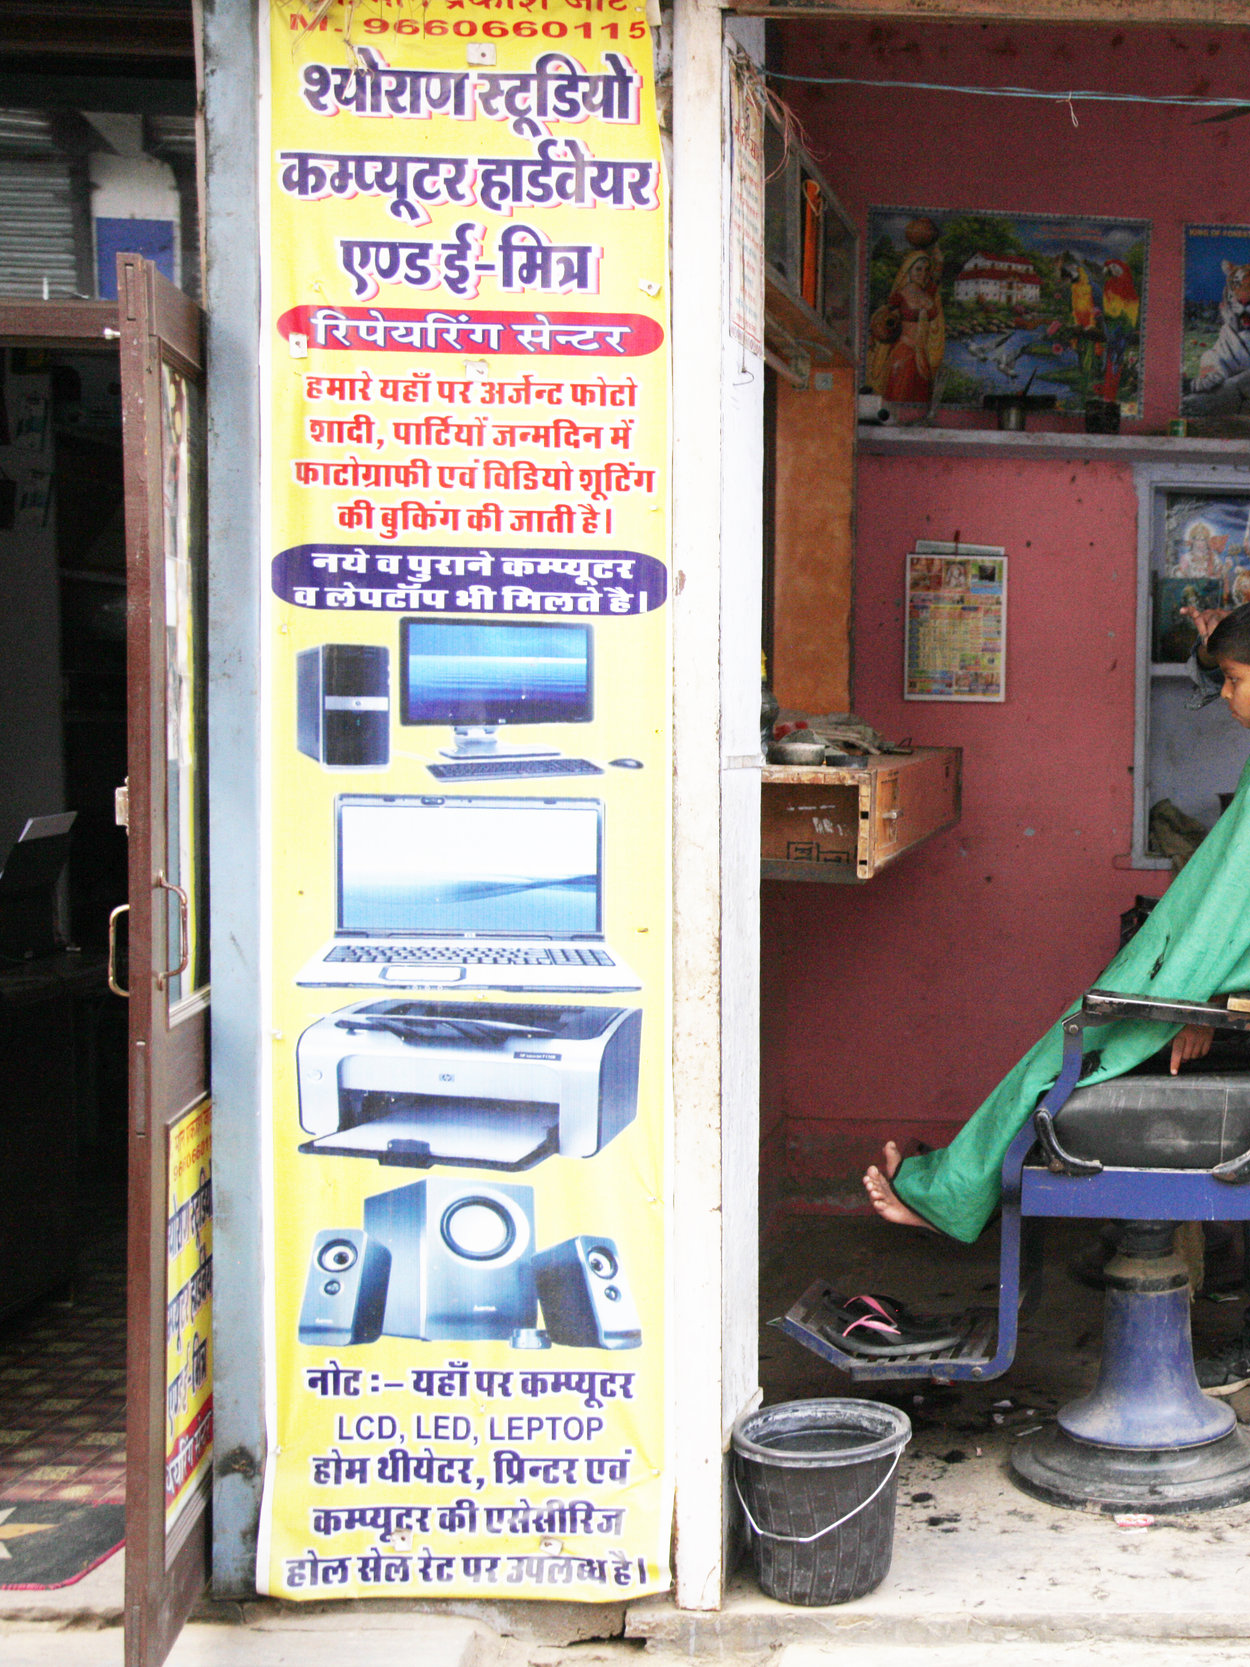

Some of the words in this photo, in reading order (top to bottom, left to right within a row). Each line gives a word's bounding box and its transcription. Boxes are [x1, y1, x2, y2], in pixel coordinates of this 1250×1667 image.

[364, 19, 645, 39] 9660660115
[305, 48, 469, 114] श्योराण
[477, 54, 633, 140] स्टूडियो
[281, 153, 469, 219] कम्प्यूटर
[478, 139, 651, 209] हार्डवेयर
[340, 240, 433, 296] एण्ड
[442, 223, 590, 293] ई-मित्र
[311, 309, 504, 350] रिपेयरिंग
[511, 314, 633, 353] सेन्टर
[307, 371, 372, 400] हमारे
[438, 381, 473, 403] पर
[481, 375, 563, 404] अर्जेन्ट
[571, 377, 637, 406] फोटो
[310, 415, 383, 449] शादी,
[394, 416, 488, 446] पार्टियों
[493, 419, 602, 448] जन्मदिन
[611, 420, 634, 449] में
[438, 460, 479, 488] एवं
[484, 461, 573, 491] विडियो
[580, 462, 655, 500] शूटिंग
[338, 500, 374, 529] की
[380, 501, 460, 539] बुकिंग
[467, 503, 502, 531] की
[511, 504, 576, 533] जाती
[312, 549, 369, 573] नये
[376, 555, 402, 574] व
[408, 552, 496, 582] पुराने
[500, 560, 635, 585] कम्प्यूटर
[293, 587, 319, 611] व
[325, 583, 450, 609] लेपटॉप
[456, 587, 499, 610] भी
[503, 588, 600, 611] मिलते
[475, 1372, 511, 1396] पर
[522, 1373, 632, 1407] कम्प्यूटर
[339, 1416, 404, 1444] LCD,
[417, 1416, 477, 1446] LED,
[490, 1418, 602, 1440] LEPTOP
[313, 1450, 368, 1484] होम
[378, 1449, 484, 1489] थीयेटर,
[494, 1451, 577, 1484] प्रिन्टर
[587, 1450, 631, 1483] एवं
[314, 1507, 431, 1542] कम्प्यूटर
[438, 1500, 476, 1531] की
[486, 1500, 625, 1533] एसेसीरिज
[289, 1551, 350, 1586] होल
[358, 1548, 409, 1581] सेल
[419, 1547, 454, 1581] रेट
[463, 1558, 499, 1584] पर
[506, 1557, 605, 1585] उपलब्ध
